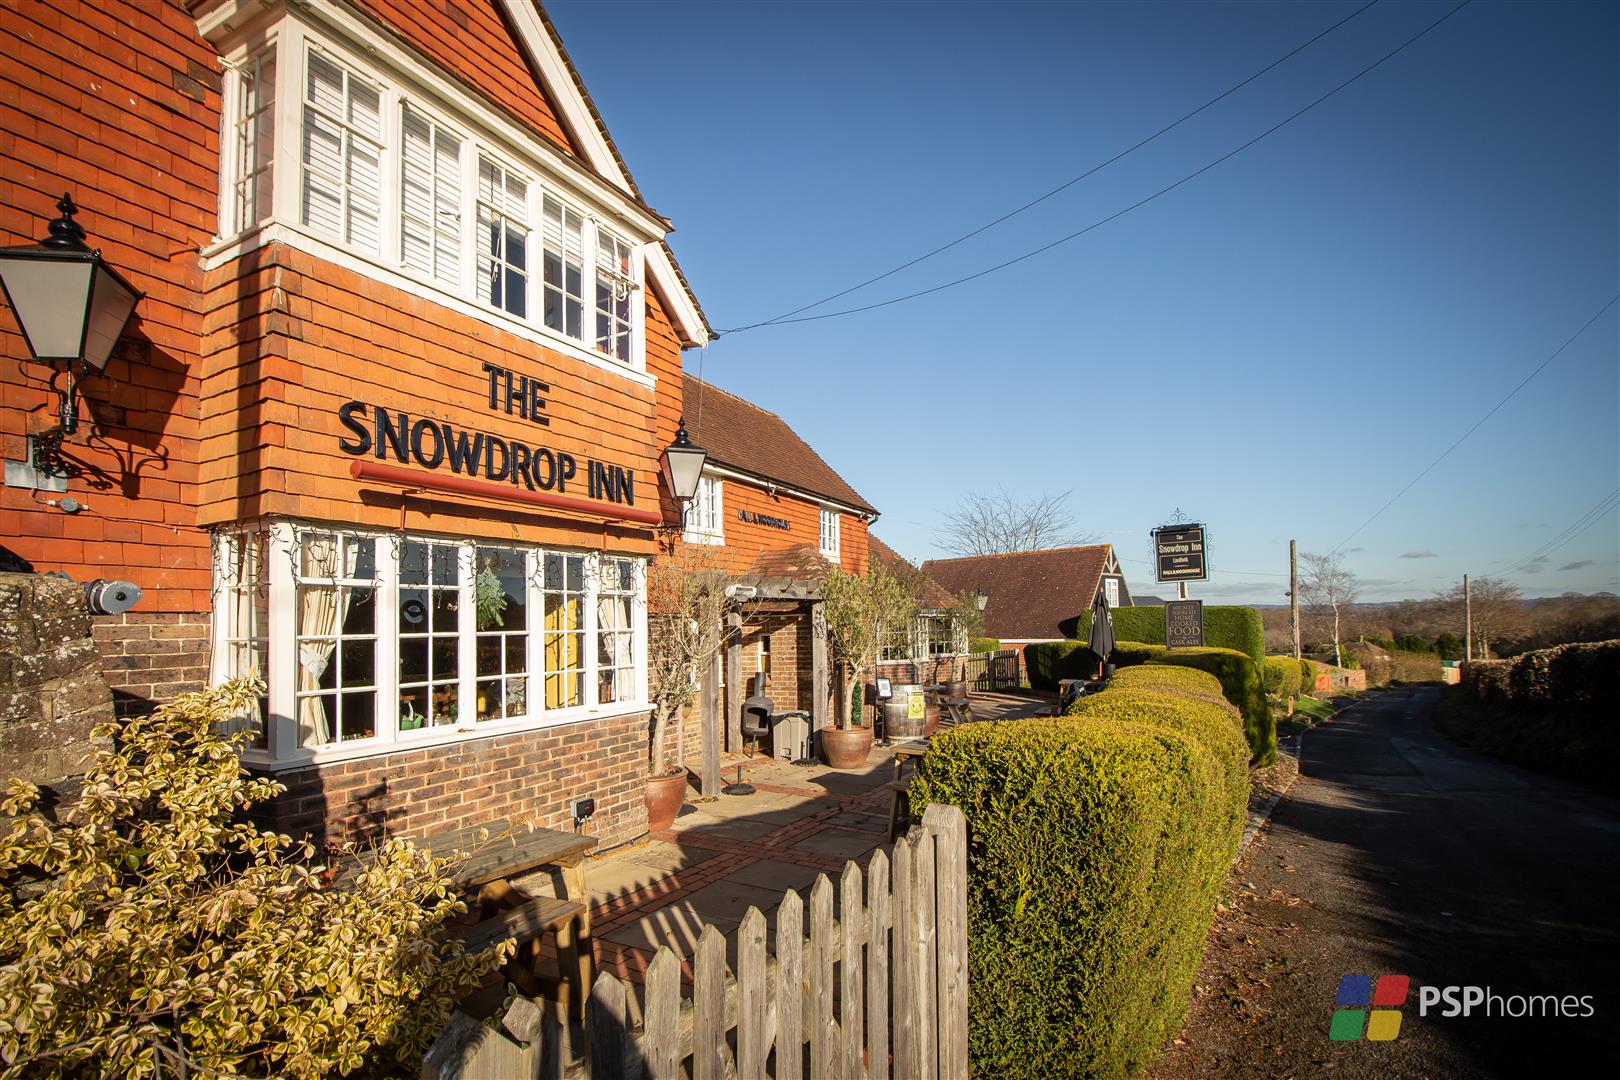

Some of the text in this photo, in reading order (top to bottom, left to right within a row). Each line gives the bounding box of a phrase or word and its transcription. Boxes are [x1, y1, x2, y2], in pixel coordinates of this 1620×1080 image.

[482, 363, 550, 426] THE
[339, 401, 634, 506] SNOWDROP INN
[1159, 543, 1201, 553] Snowdrop Inn
[1169, 626, 1200, 636] FOOD
